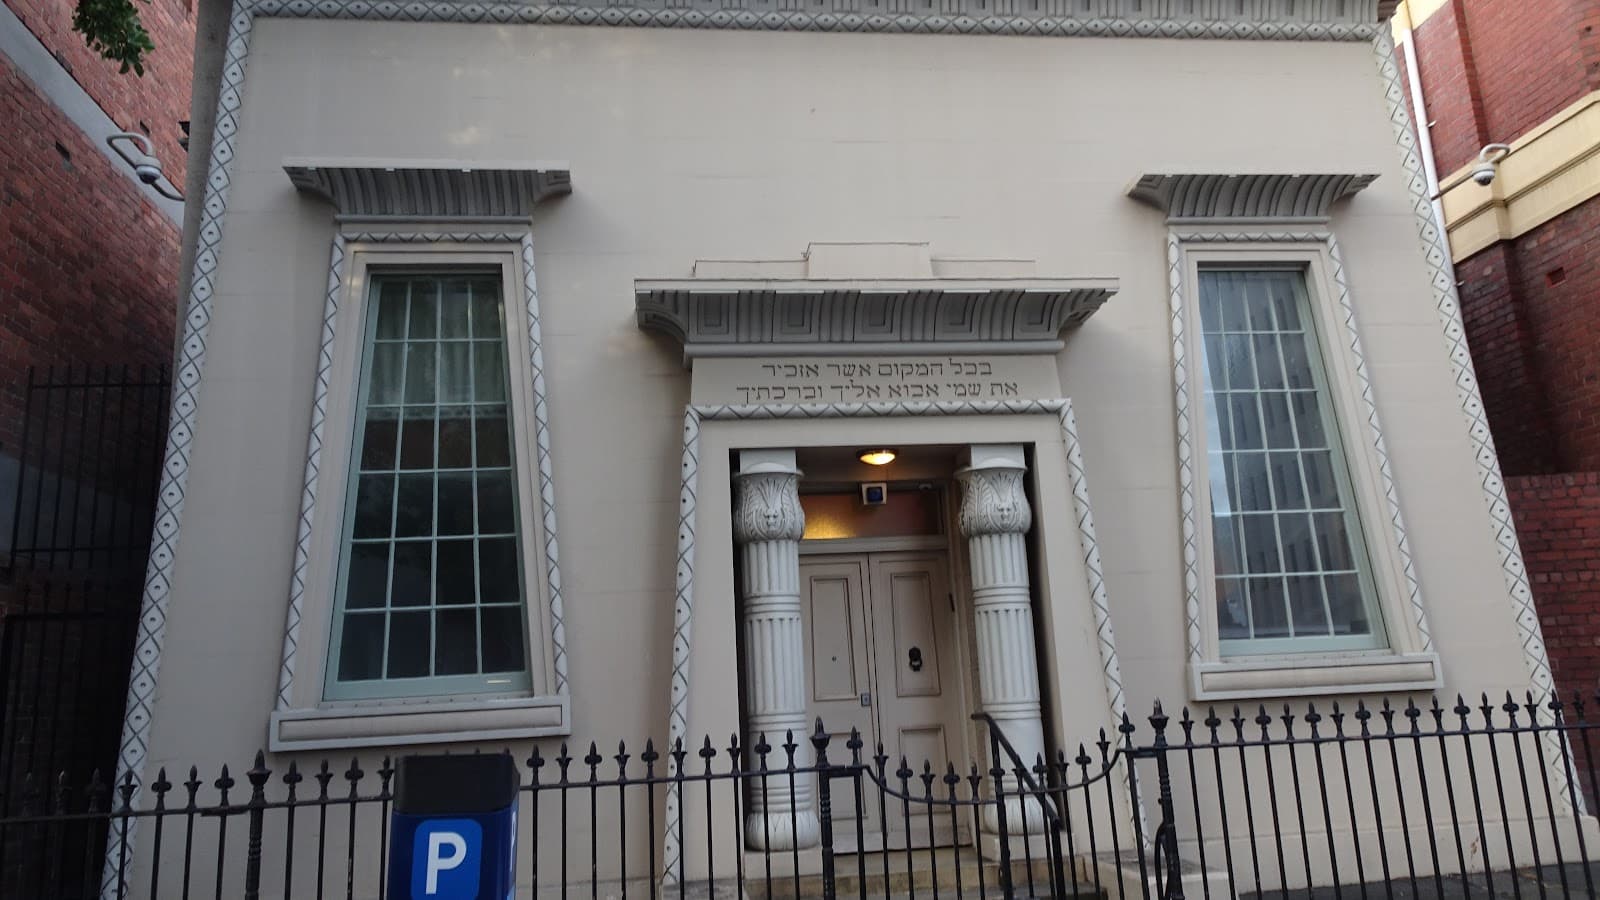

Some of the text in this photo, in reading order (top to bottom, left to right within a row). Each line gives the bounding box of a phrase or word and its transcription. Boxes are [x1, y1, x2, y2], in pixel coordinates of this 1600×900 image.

[761, 357, 992, 381] בכל המקום אשר אזכיר
[736, 378, 1018, 405] את שמי אבוא אליך וברכתיך
[425, 831, 467, 895] P
